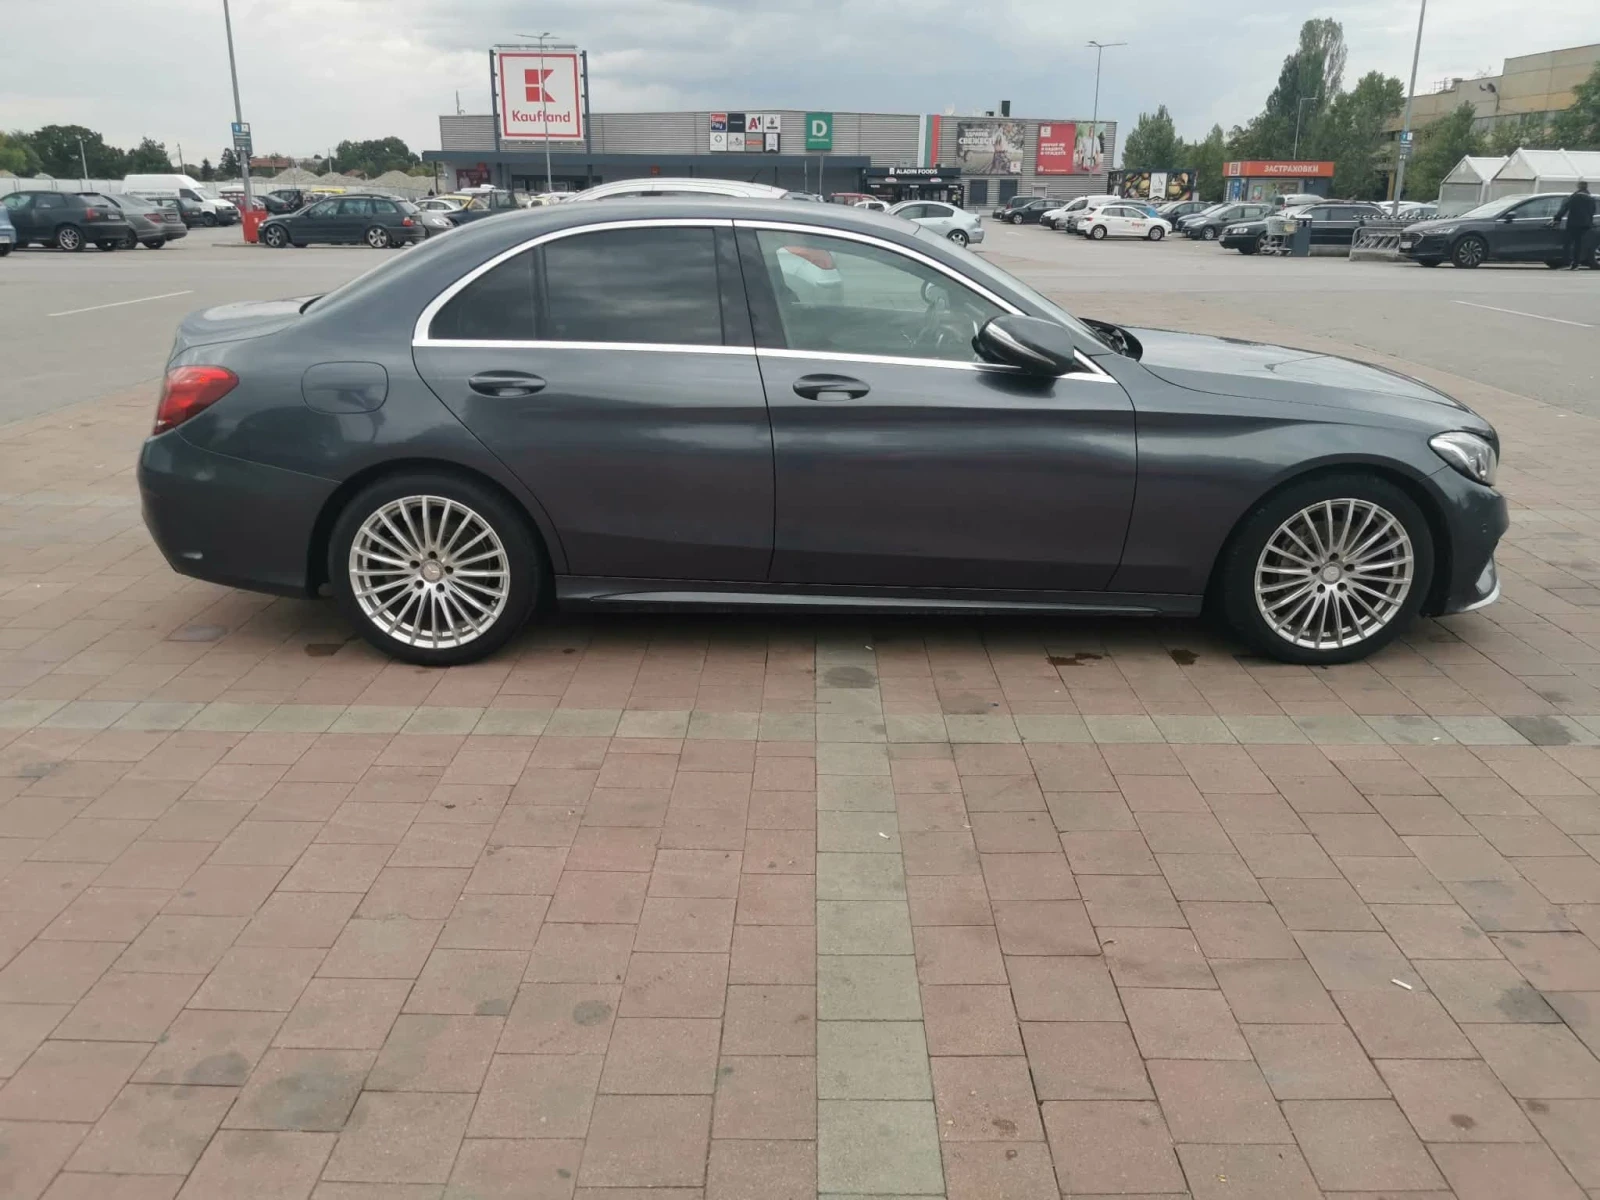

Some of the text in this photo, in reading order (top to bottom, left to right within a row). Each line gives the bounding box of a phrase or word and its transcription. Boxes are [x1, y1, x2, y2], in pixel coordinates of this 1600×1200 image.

[512, 110, 570, 122] Kaufland
[748, 116, 761, 130] A1
[812, 120, 827, 137] D
[1264, 164, 1318, 173] ЗАСТРАХОВКИ
